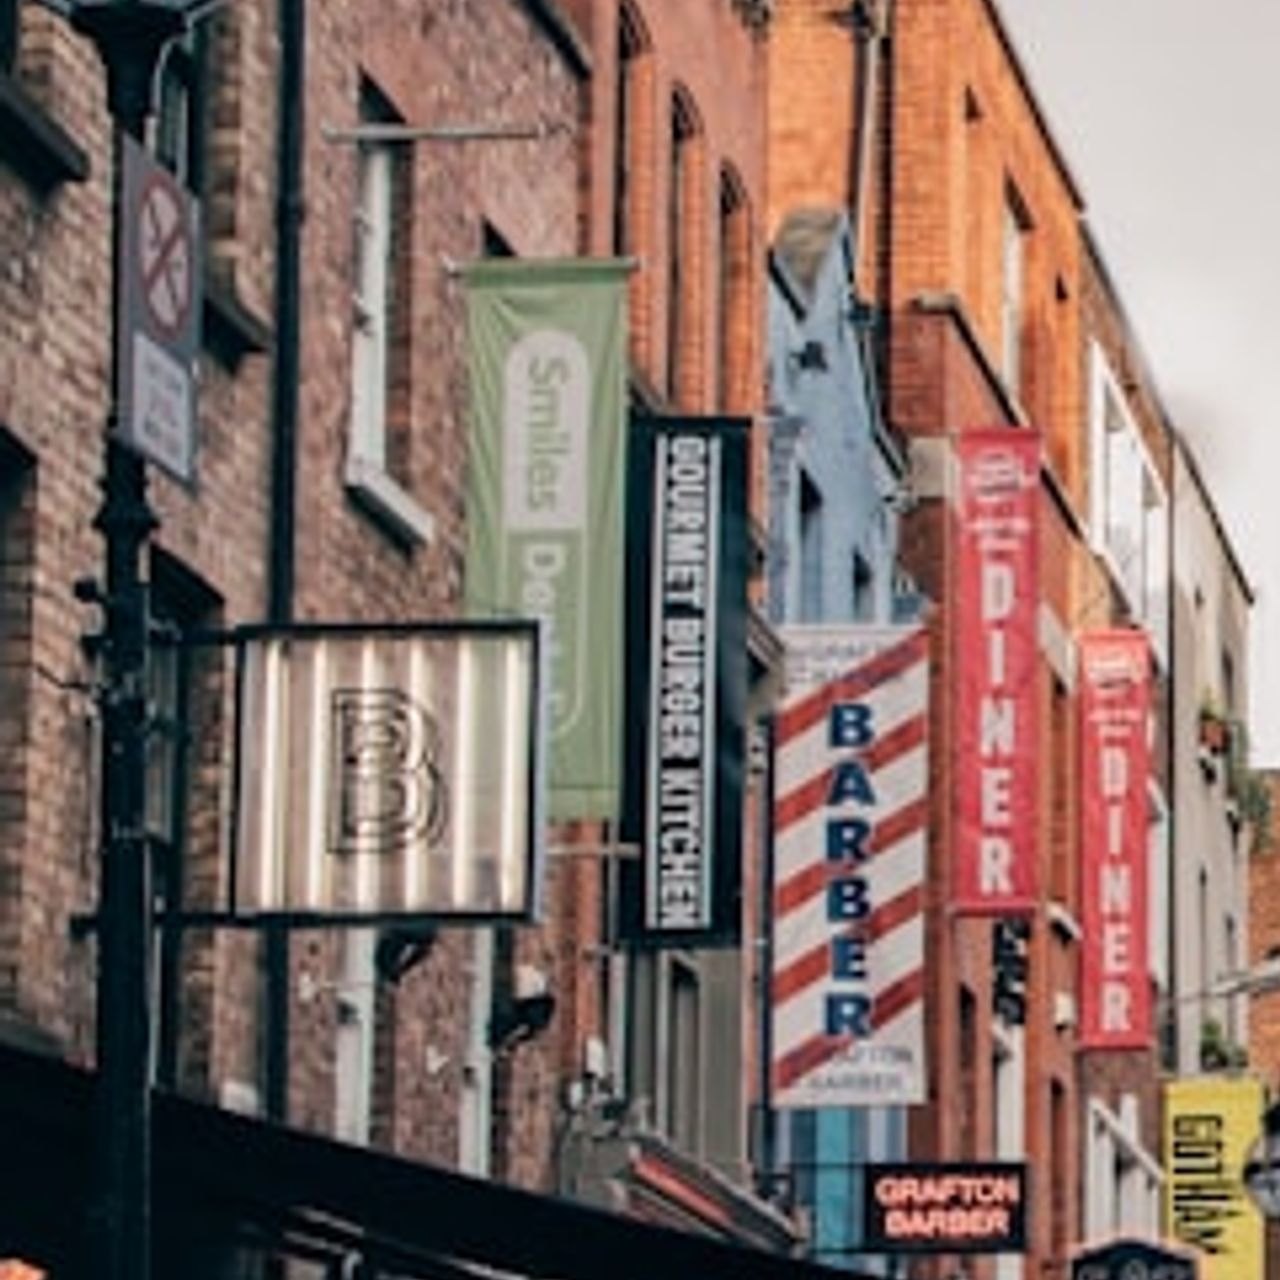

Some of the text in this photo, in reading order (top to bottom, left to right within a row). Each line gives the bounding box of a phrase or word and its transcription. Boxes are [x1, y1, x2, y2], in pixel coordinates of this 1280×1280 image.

[526, 356, 570, 513] Smiles
[328, 688, 447, 854] B
[660, 435, 707, 929] GOURMET BURGER KITCHEN
[979, 563, 1019, 895] DINER
[824, 703, 876, 1039] BARBER
[1101, 746, 1133, 1033] DINER
[875, 1176, 1019, 1206] GRAFTON
[885, 1208, 1010, 1238] BARBER
